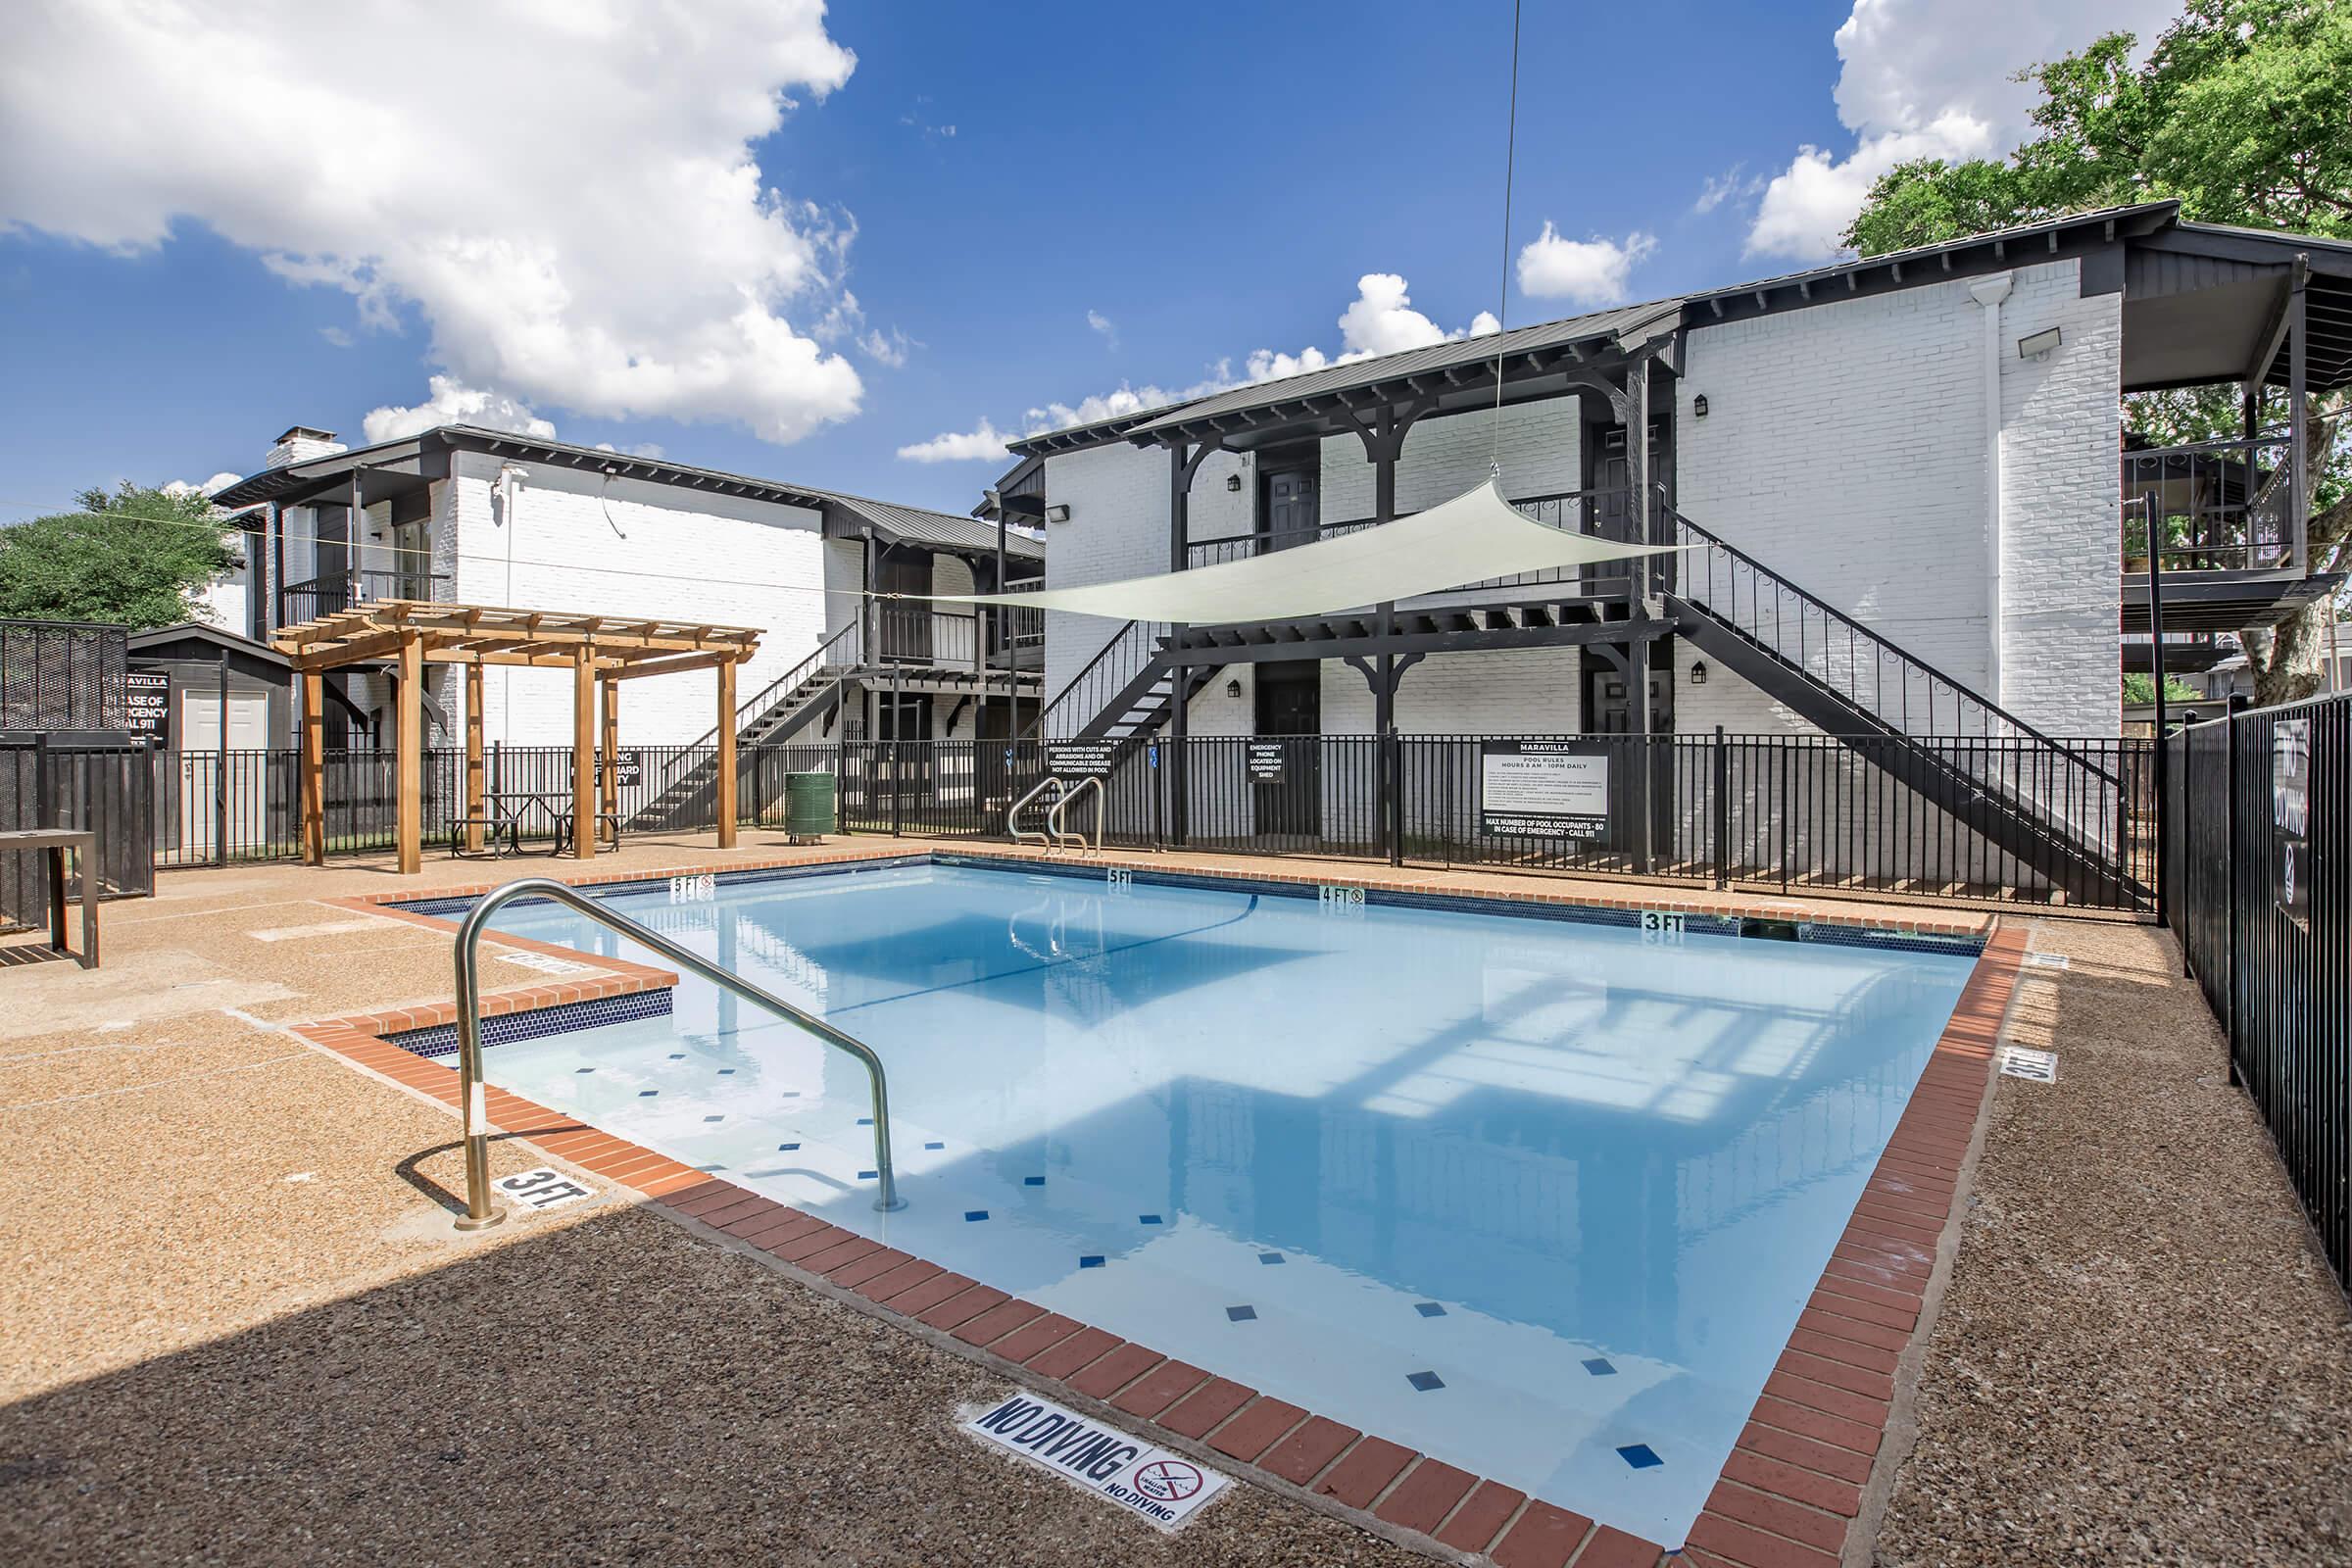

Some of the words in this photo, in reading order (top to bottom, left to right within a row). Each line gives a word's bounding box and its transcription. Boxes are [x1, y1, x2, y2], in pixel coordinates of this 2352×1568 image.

[148, 697, 164, 707] OF
[140, 719, 155, 729] 911
[2283, 735, 2297, 777] NO
[2276, 787, 2306, 837] DIVING
[1527, 827, 1565, 836] EMERGENCY
[1553, 821, 1592, 830] OCCUPANTS
[1110, 869, 1117, 882] 5
[675, 878, 681, 892] 5
[1323, 887, 1330, 902] 4
[1335, 888, 1349, 903] FT
[1646, 913, 1660, 930] 3
[502, 1171, 557, 1191] 3
[976, 1397, 1044, 1435] NO
[1010, 1413, 1139, 1482] DIVING
[1140, 1477, 1168, 1492] SHALLOW
[1143, 1485, 1165, 1497] WATER
[1103, 1482, 1128, 1497] NO
[1124, 1493, 1176, 1521] DIVING
